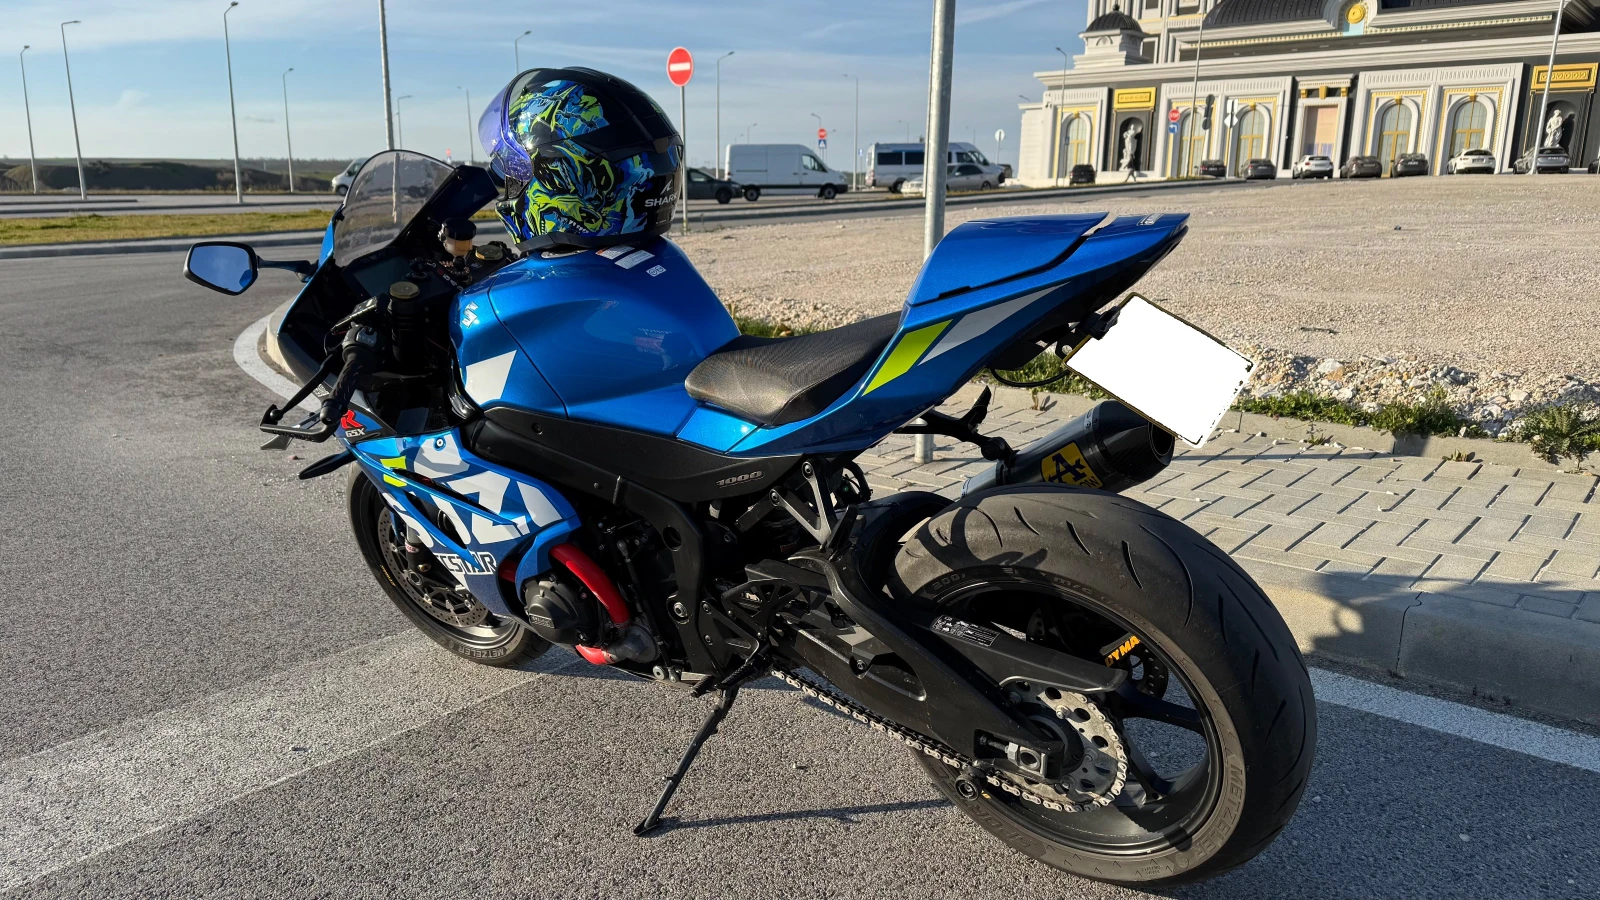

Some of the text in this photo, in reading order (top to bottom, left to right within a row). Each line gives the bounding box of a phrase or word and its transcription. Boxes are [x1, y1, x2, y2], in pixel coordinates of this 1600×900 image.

[345, 428, 366, 438] GSX
[715, 471, 763, 487] 1000
[459, 645, 505, 659] METZELER
[1105, 635, 1141, 667] DYMA
[1195, 763, 1243, 859] METZELER
